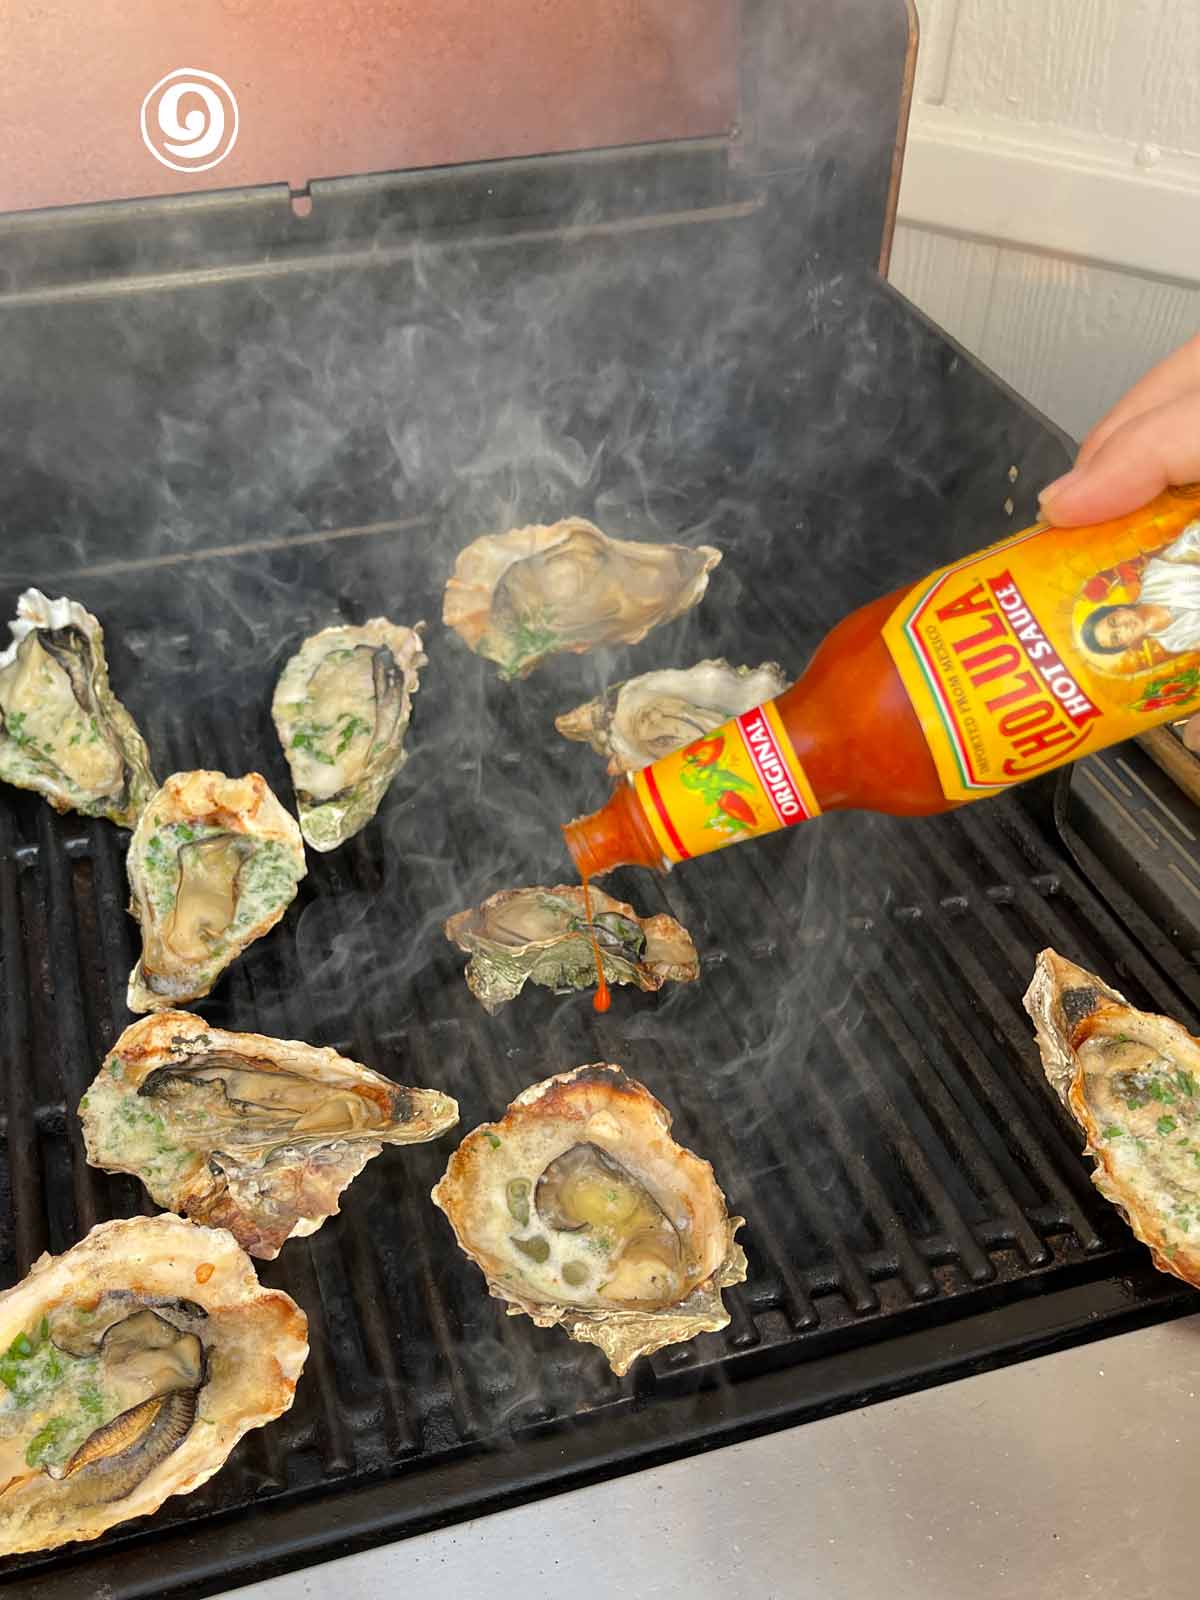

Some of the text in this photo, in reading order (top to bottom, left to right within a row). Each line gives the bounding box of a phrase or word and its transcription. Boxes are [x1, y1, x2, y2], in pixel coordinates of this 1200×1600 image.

[925, 624, 991, 775] IMPORTED FROM MEXICO
[935, 583, 1094, 776] CHOLULA
[994, 582, 1093, 718] HOT SAUCE
[745, 717, 800, 816] ORIGINAL
